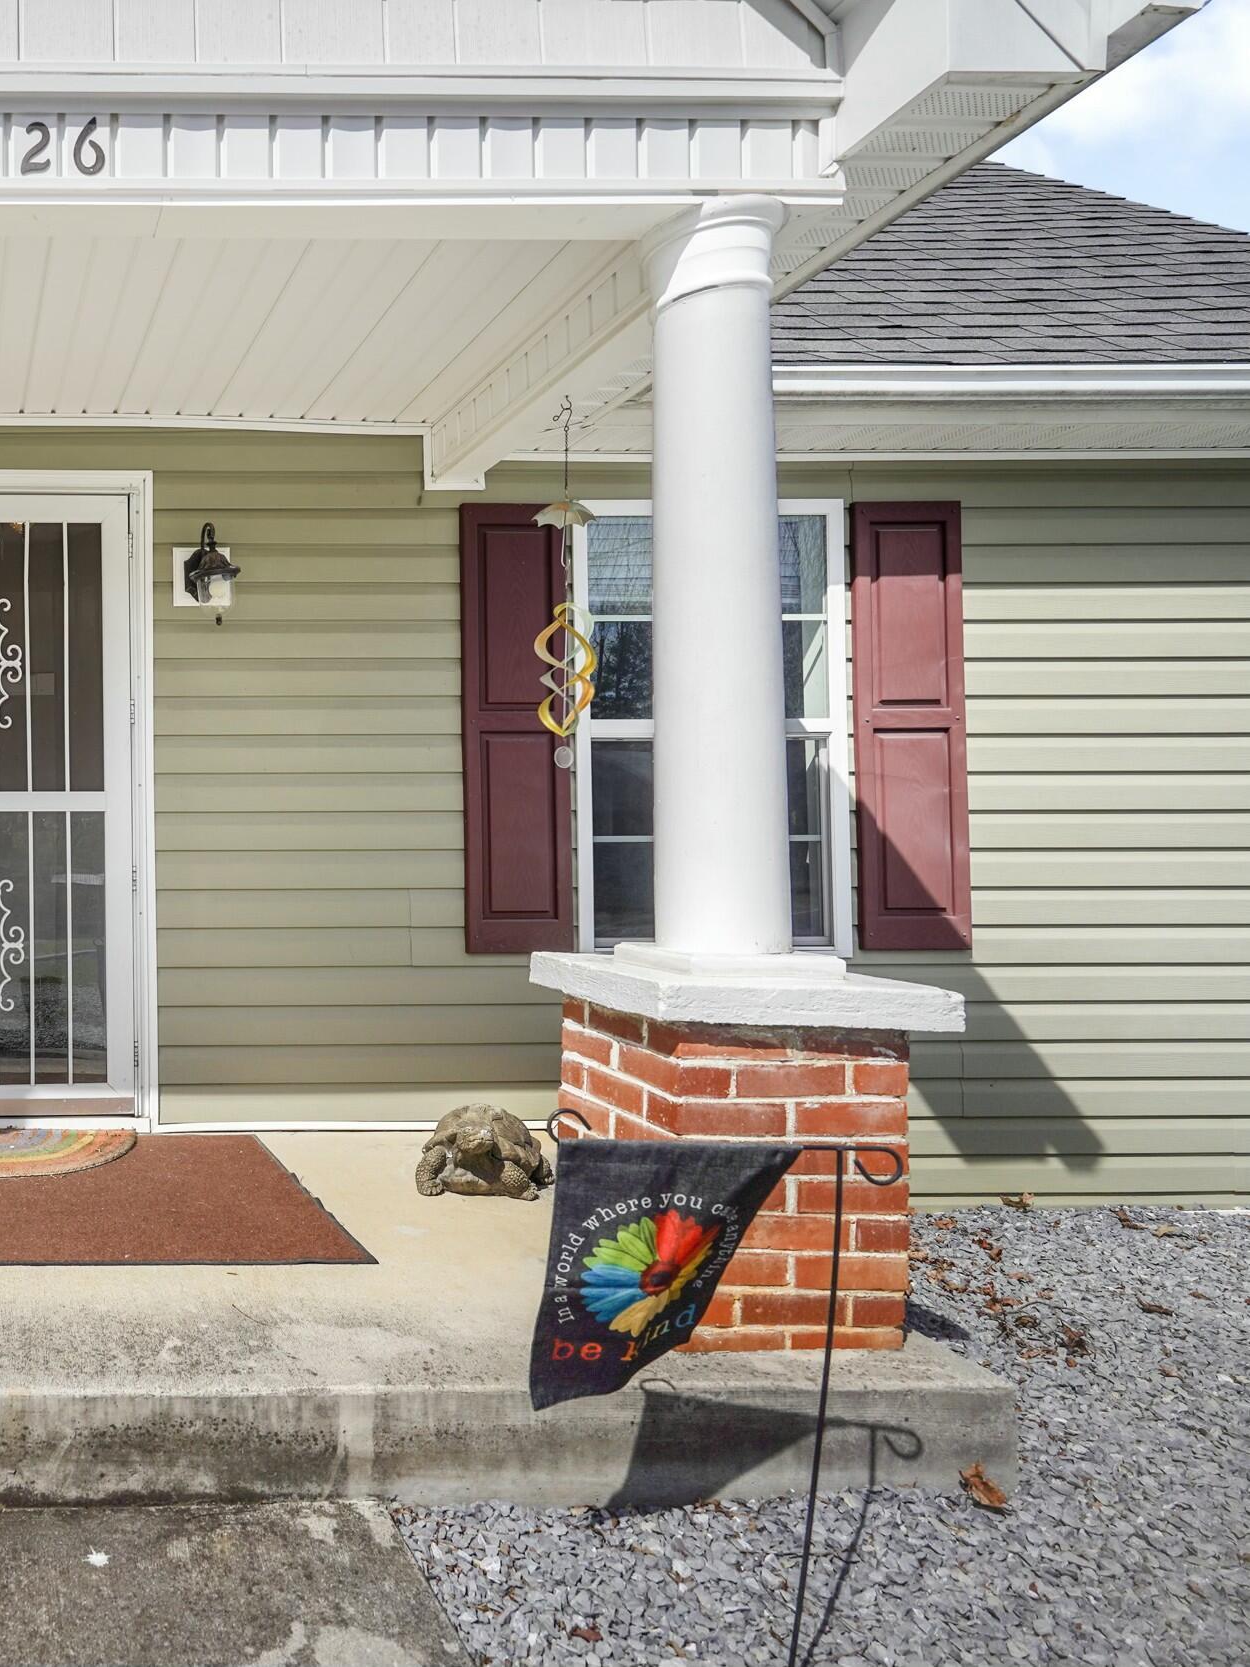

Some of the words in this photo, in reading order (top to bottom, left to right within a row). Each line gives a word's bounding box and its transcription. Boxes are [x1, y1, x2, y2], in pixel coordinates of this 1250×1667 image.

[581, 1196, 652, 1231] where
[659, 1193, 703, 1210] you
[554, 1232, 586, 1289] world
[554, 1294, 568, 1304] a
[552, 1337, 602, 1361] be
